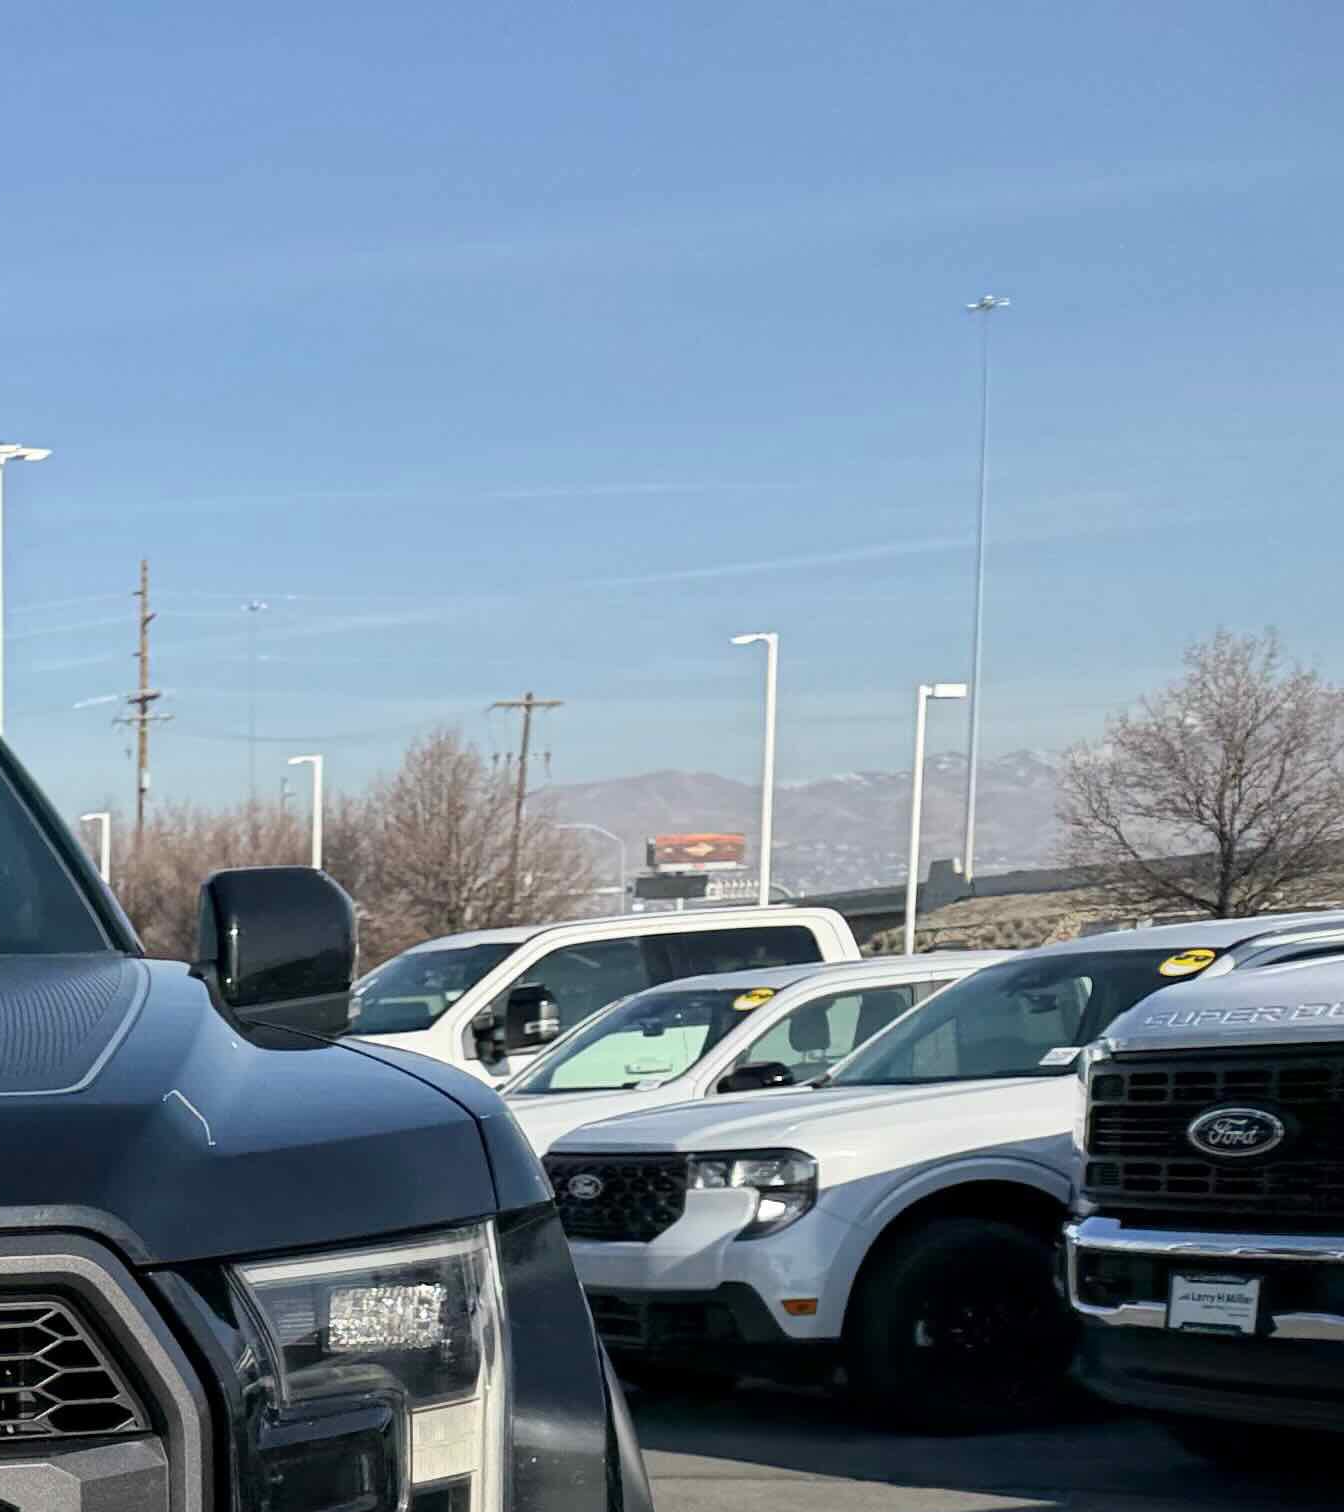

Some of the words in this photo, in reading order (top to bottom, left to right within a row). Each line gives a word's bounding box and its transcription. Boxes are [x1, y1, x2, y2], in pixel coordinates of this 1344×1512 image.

[1143, 1006, 1289, 1027] SUPER
[1208, 1118, 1259, 1145] Ford
[1191, 1291, 1215, 1303] Larry
